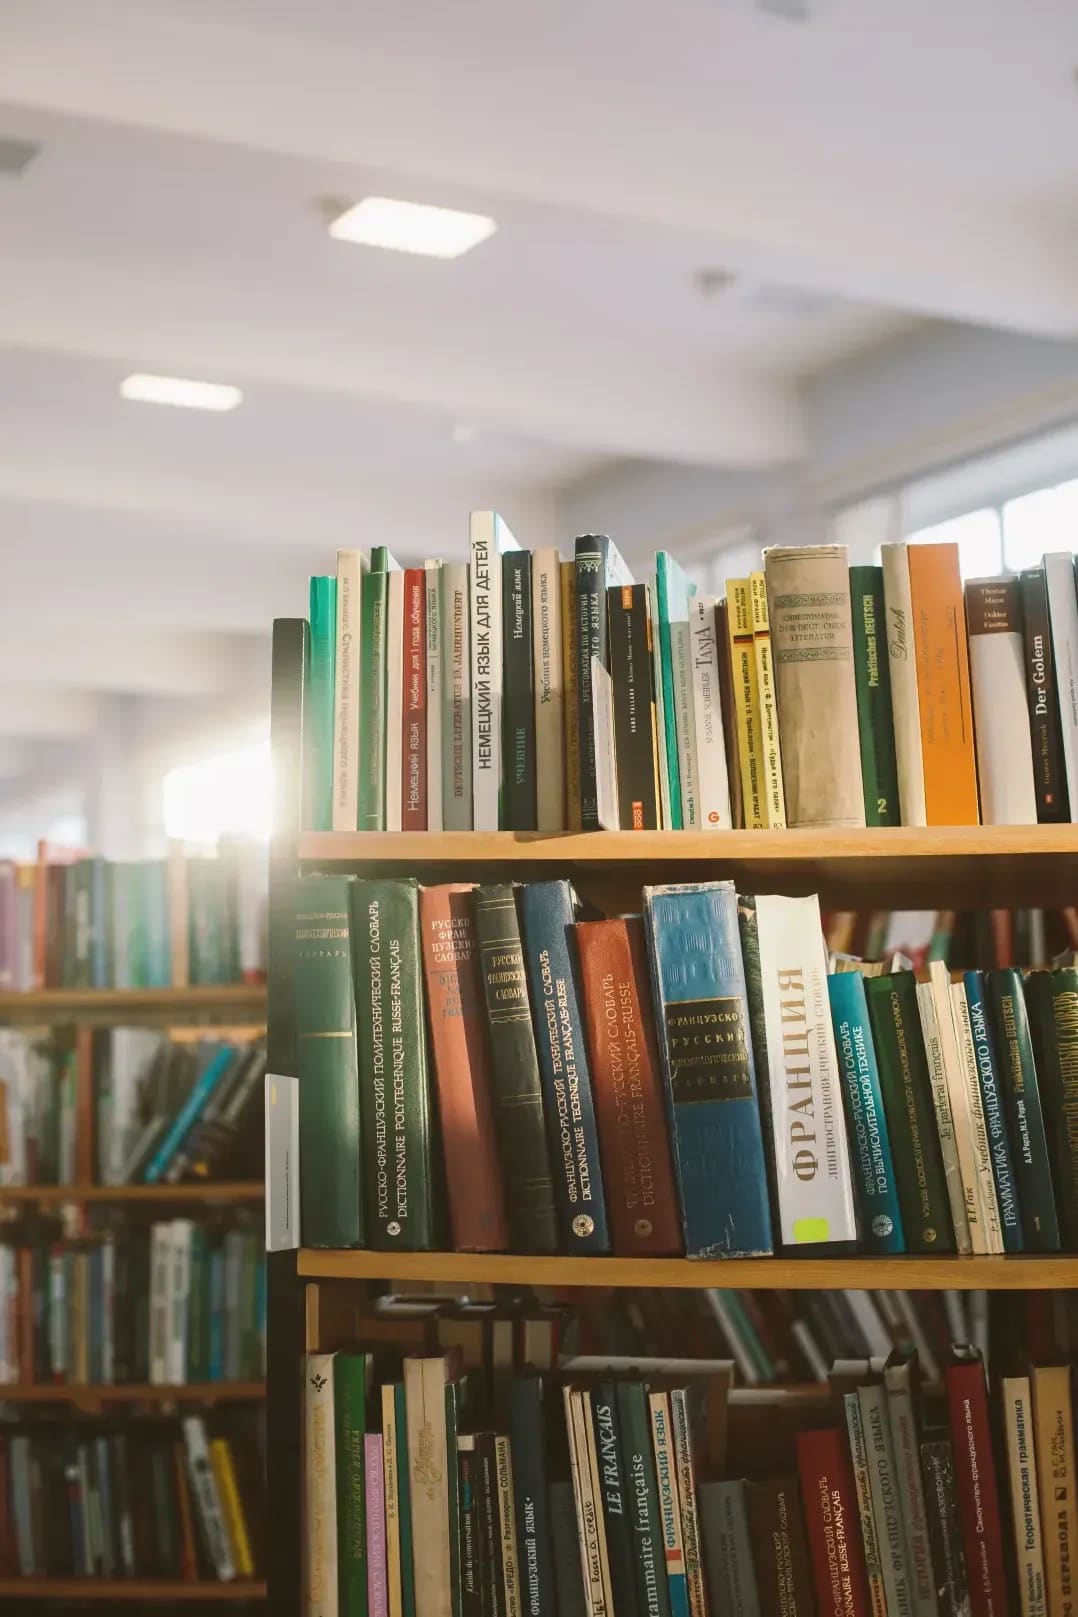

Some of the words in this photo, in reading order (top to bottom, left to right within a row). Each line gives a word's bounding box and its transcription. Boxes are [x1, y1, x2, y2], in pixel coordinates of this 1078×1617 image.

[472, 540, 489, 589] ДЕТЕЙ
[513, 568, 521, 591] язык
[411, 585, 420, 623] обучения
[452, 590, 462, 664] JAHRHUNDERT
[474, 594, 490, 627] ДЛЯ
[511, 593, 524, 638] Немецкий
[578, 594, 588, 632] ИСТОРИИ
[590, 591, 600, 629] ЯЗЫКА
[862, 594, 875, 635] DEUTSCH
[412, 626, 420, 646] года
[475, 631, 490, 674] ЯЗЫК
[541, 605, 550, 657] немецкого
[580, 635, 588, 646] ПО
[693, 626, 715, 668] TANJA
[890, 607, 908, 661] Deutsch
[411, 654, 419, 669] для
[540, 660, 551, 703] Учебник
[580, 648, 590, 703] ХРЕСТОМАТИЯ
[865, 636, 879, 687] Praktisches
[1030, 634, 1045, 683] Golem
[410, 673, 419, 709] Учебник
[1034, 687, 1047, 714] Der
[410, 721, 418, 749] язык
[475, 680, 493, 768] НЕМЕЦКИЙ
[515, 727, 526, 784] УЧЕБНИК
[408, 753, 419, 810] Немецкий
[877, 798, 887, 813] 2
[686, 797, 695, 824] Deutsch
[367, 901, 380, 953] СЛОВАРЬ
[438, 929, 467, 941] ФРАН
[435, 952, 471, 963] СЛОВАР
[539, 950, 553, 994] СЛОВАРЬ
[390, 939, 404, 1031] RUSSE-FRANÇAIS
[600, 973, 619, 1038] СЛОВАРЬ
[368, 958, 383, 1074] ПОЛИТЕХНИЧЕСКИЙ
[544, 999, 562, 1074] ТЕХНИЧЕСКИЙ
[556, 978, 574, 1060] FRANÇAIS-RUSSE
[618, 982, 643, 1097] FRANÇAIS-RUSSE
[671, 1028, 745, 1048] РУССКИЙ
[969, 1001, 987, 1041] ЯЗЫКА
[1000, 994, 1017, 1038] DEUTSCH
[838, 1020, 855, 1067] СЛОВАРЬ
[852, 1024, 869, 1072] ТЕХНИКЕ
[925, 1036, 944, 1081] français
[1007, 1038, 1025, 1093] Praktisches
[393, 1037, 406, 1129] POLYTECHNIQUE
[566, 1064, 582, 1121] TECHNIQUE
[775, 966, 820, 1182] ФРАНЦИЯ
[976, 1043, 1003, 1137] ФРАНЦУЗСКОГО
[859, 1074, 886, 1174] ВЫЧИСЛИТЕЛЬНОЙ
[932, 1084, 951, 1124] parlerai
[373, 1078, 389, 1217] РУССКО-ФРАНЦУЗСКИЙ
[554, 1078, 577, 1202] ФРАНЦУЗСКО-РУССКИЙ
[846, 1069, 876, 1195] ФРАНЦУЗСКО-РУССКИЙ
[939, 1127, 952, 1140] Je
[974, 1122, 990, 1172] Учебник
[395, 1135, 407, 1216] DICTIONNAIRE
[574, 1126, 592, 1200] DICTIONNAIRE
[876, 1175, 888, 1193] ПО
[991, 1141, 1017, 1226] ГРАММАТИКА
[964, 1186, 974, 1206] Гак
[868, 1404, 886, 1451] ЯЗЫКА
[963, 1399, 973, 1423] языка
[1012, 1398, 1027, 1463] грамматика
[496, 1440, 508, 1487] СОЛЬМАНА
[596, 1403, 620, 1488] FRANÇAIS
[965, 1424, 980, 1480] французского
[500, 1489, 511, 1540] Разговорник
[524, 1502, 535, 1532] ЯЗЫК
[606, 1490, 622, 1514] LE
[631, 1454, 650, 1531] française
[656, 1450, 677, 1547] ФРАНЦУЗСКИЙ
[818, 1476, 832, 1522] СЛОВАРЬ
[876, 1458, 903, 1571] ФРАНЦУЗСКОГО
[970, 1482, 985, 1532] Самоучитель
[1017, 1467, 1034, 1550] Теоретическая
[463, 1512, 472, 1557] conversation
[830, 1489, 850, 1571] RUSSE-FRANÇAIS
[1057, 1510, 1072, 1595] ПЕРЕВОДА
[465, 1569, 474, 1591] Guide
[525, 1538, 540, 1615] ФРАНЦУЗСКИЙ
[588, 1554, 600, 1582] Roses
